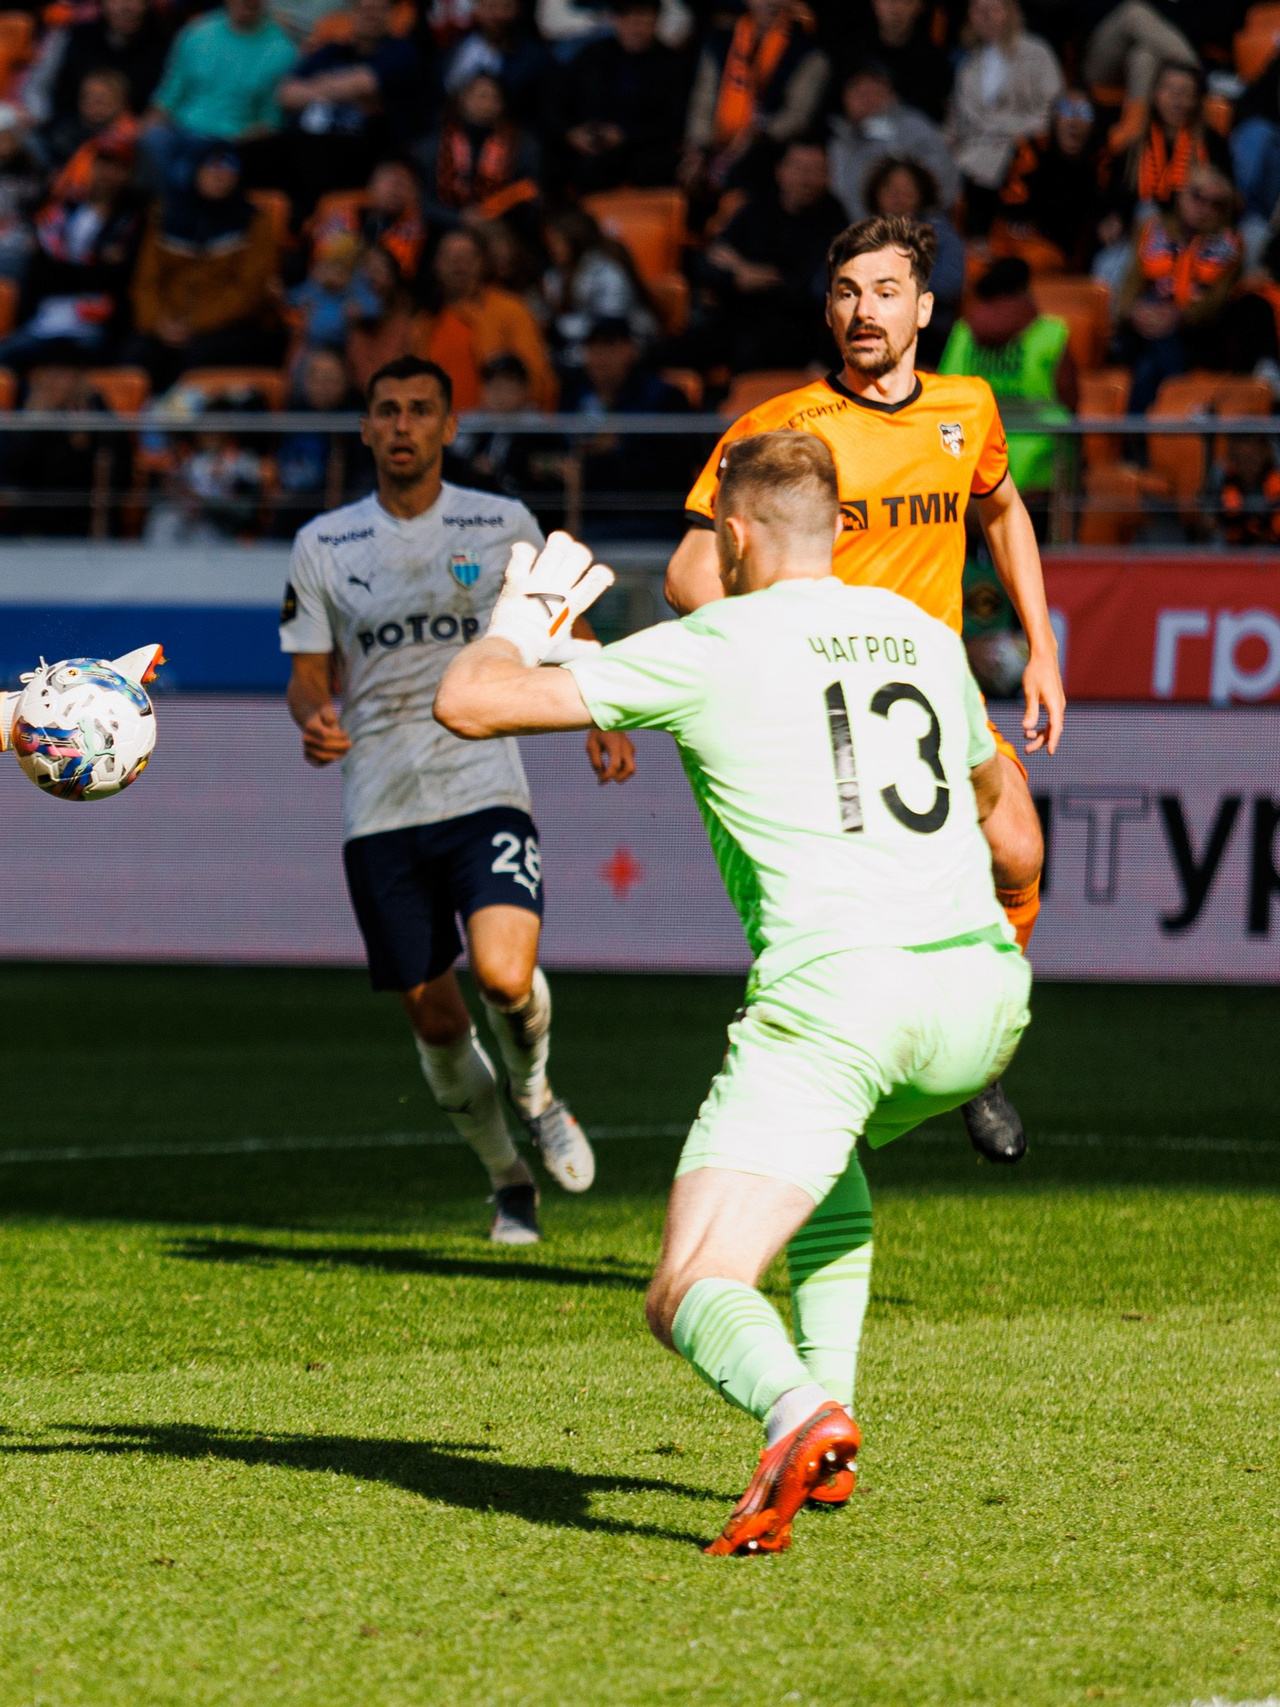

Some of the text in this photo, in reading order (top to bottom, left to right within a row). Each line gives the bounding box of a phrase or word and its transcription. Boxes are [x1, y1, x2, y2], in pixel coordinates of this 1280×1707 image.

[882, 492, 959, 527] ТМК
[357, 611, 480, 657] РОТОР
[808, 635, 917, 667] ЧАГРОВ
[823, 681, 951, 834] 13
